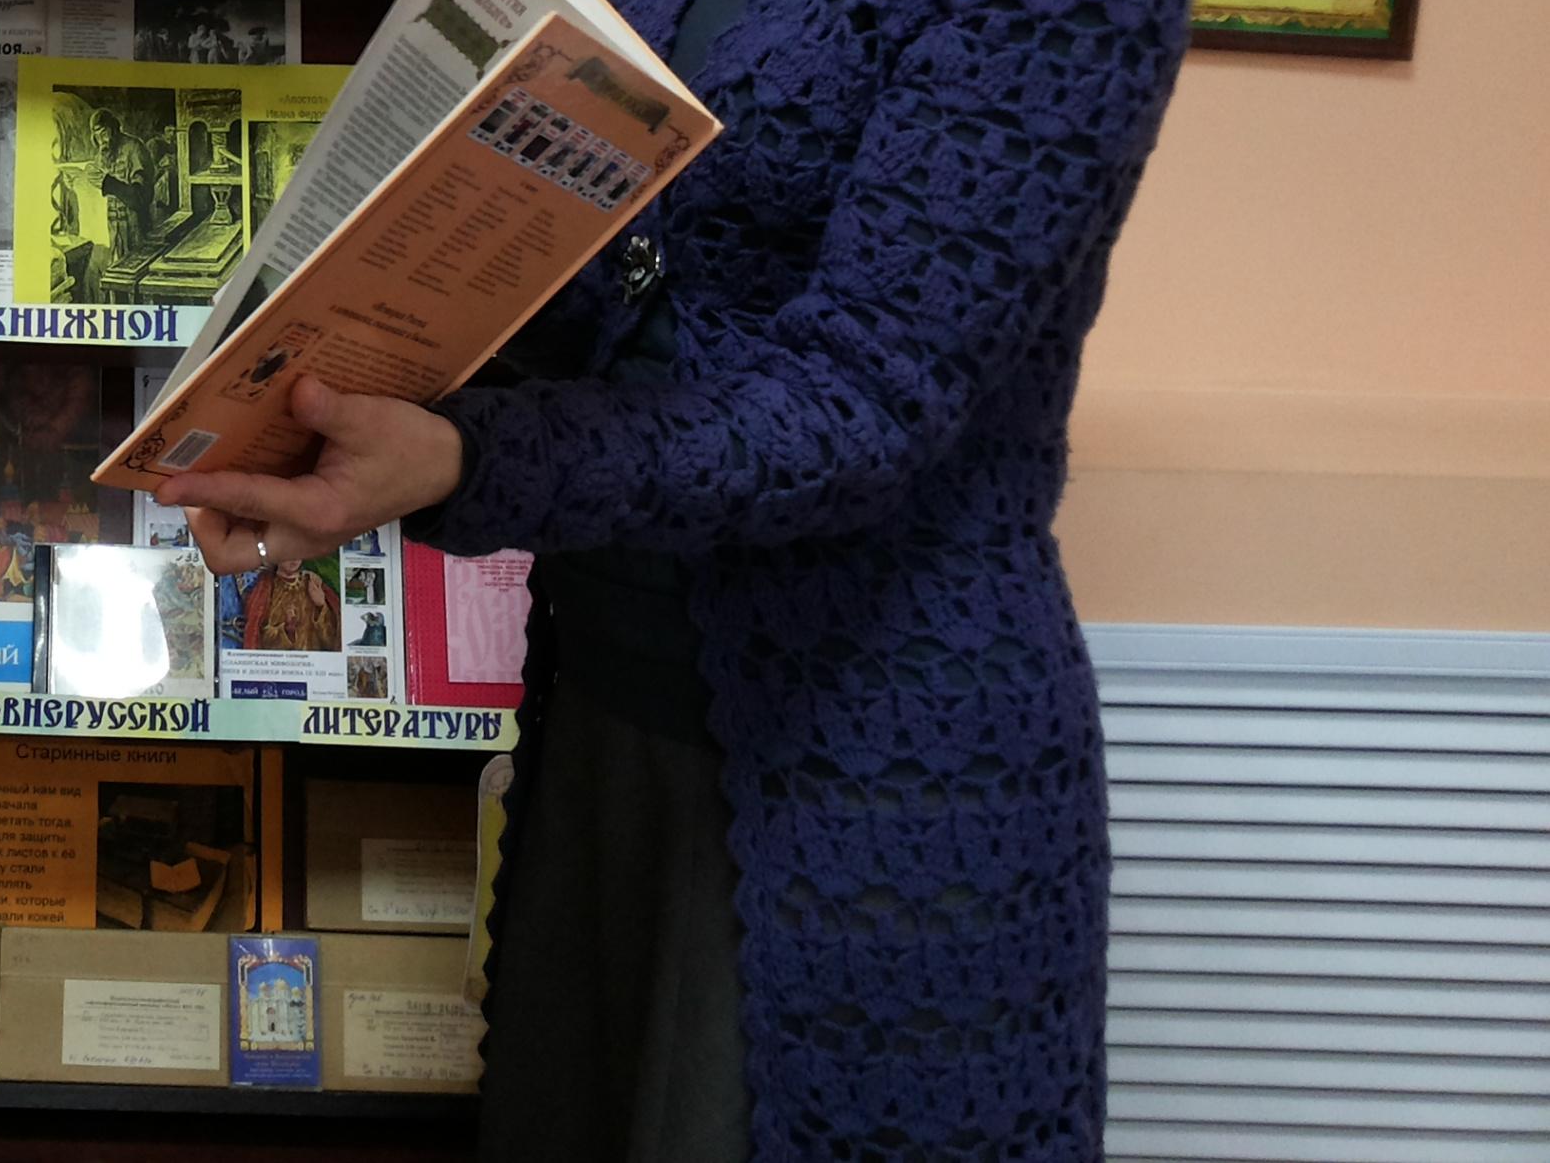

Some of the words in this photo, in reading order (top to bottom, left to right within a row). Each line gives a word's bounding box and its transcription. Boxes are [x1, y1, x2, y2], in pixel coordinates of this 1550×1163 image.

[302, 706, 503, 741] ЛИТЕРАТУРЫ
[15, 743, 122, 762] Старинные
[126, 749, 178, 764] книги
[19, 834, 67, 845] защиты
[6, 848, 48, 859] листов
[9, 864, 46, 874] стали
[14, 896, 66, 908] которые
